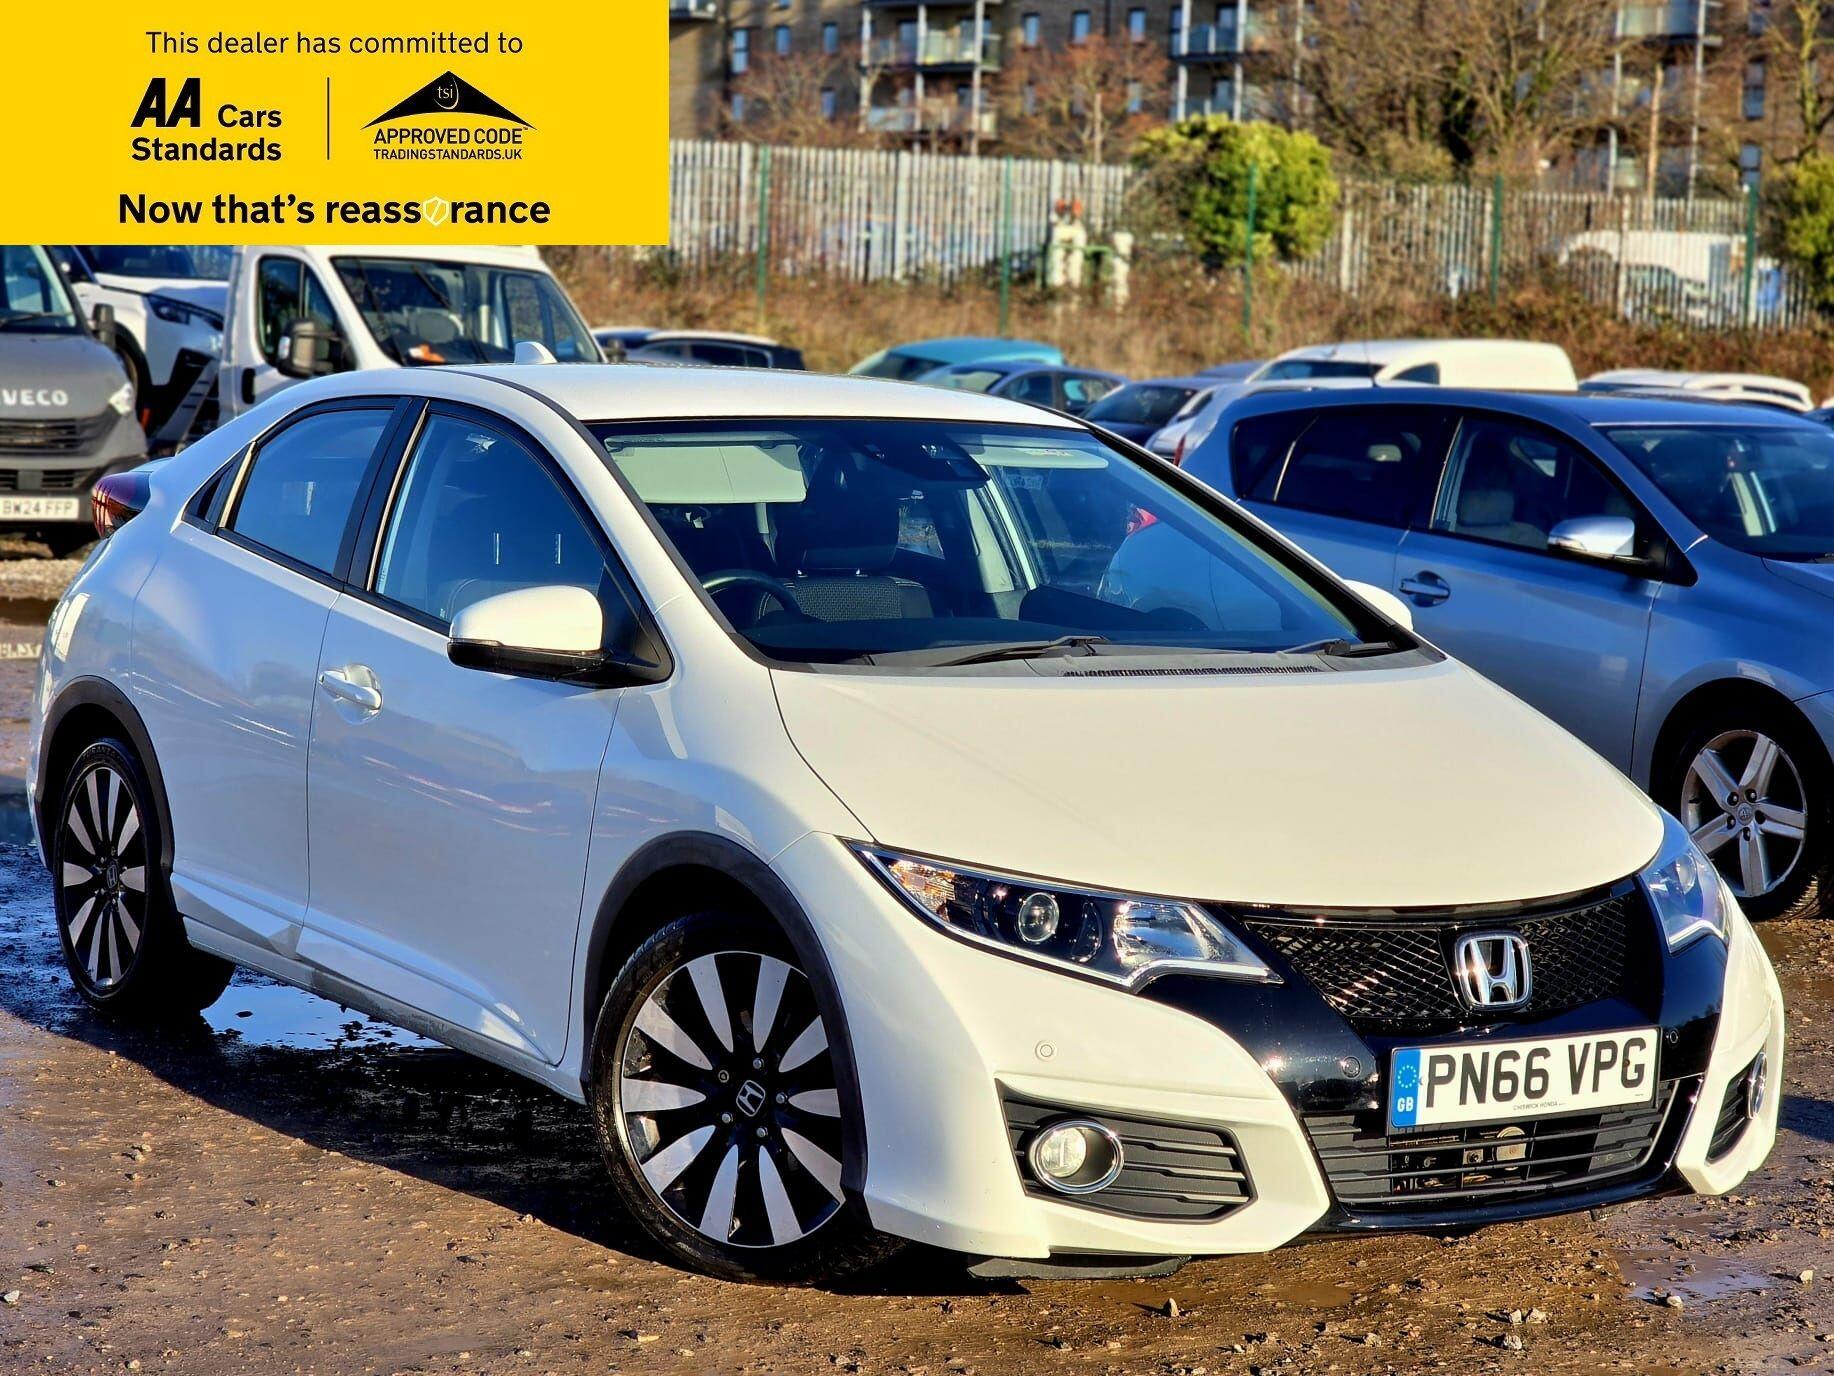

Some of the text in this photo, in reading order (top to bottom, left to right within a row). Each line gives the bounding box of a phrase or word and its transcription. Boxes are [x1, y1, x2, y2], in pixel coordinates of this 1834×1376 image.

[1425, 1036, 1647, 1108] PN66 VPG
[1396, 1096, 1414, 1112] GB
